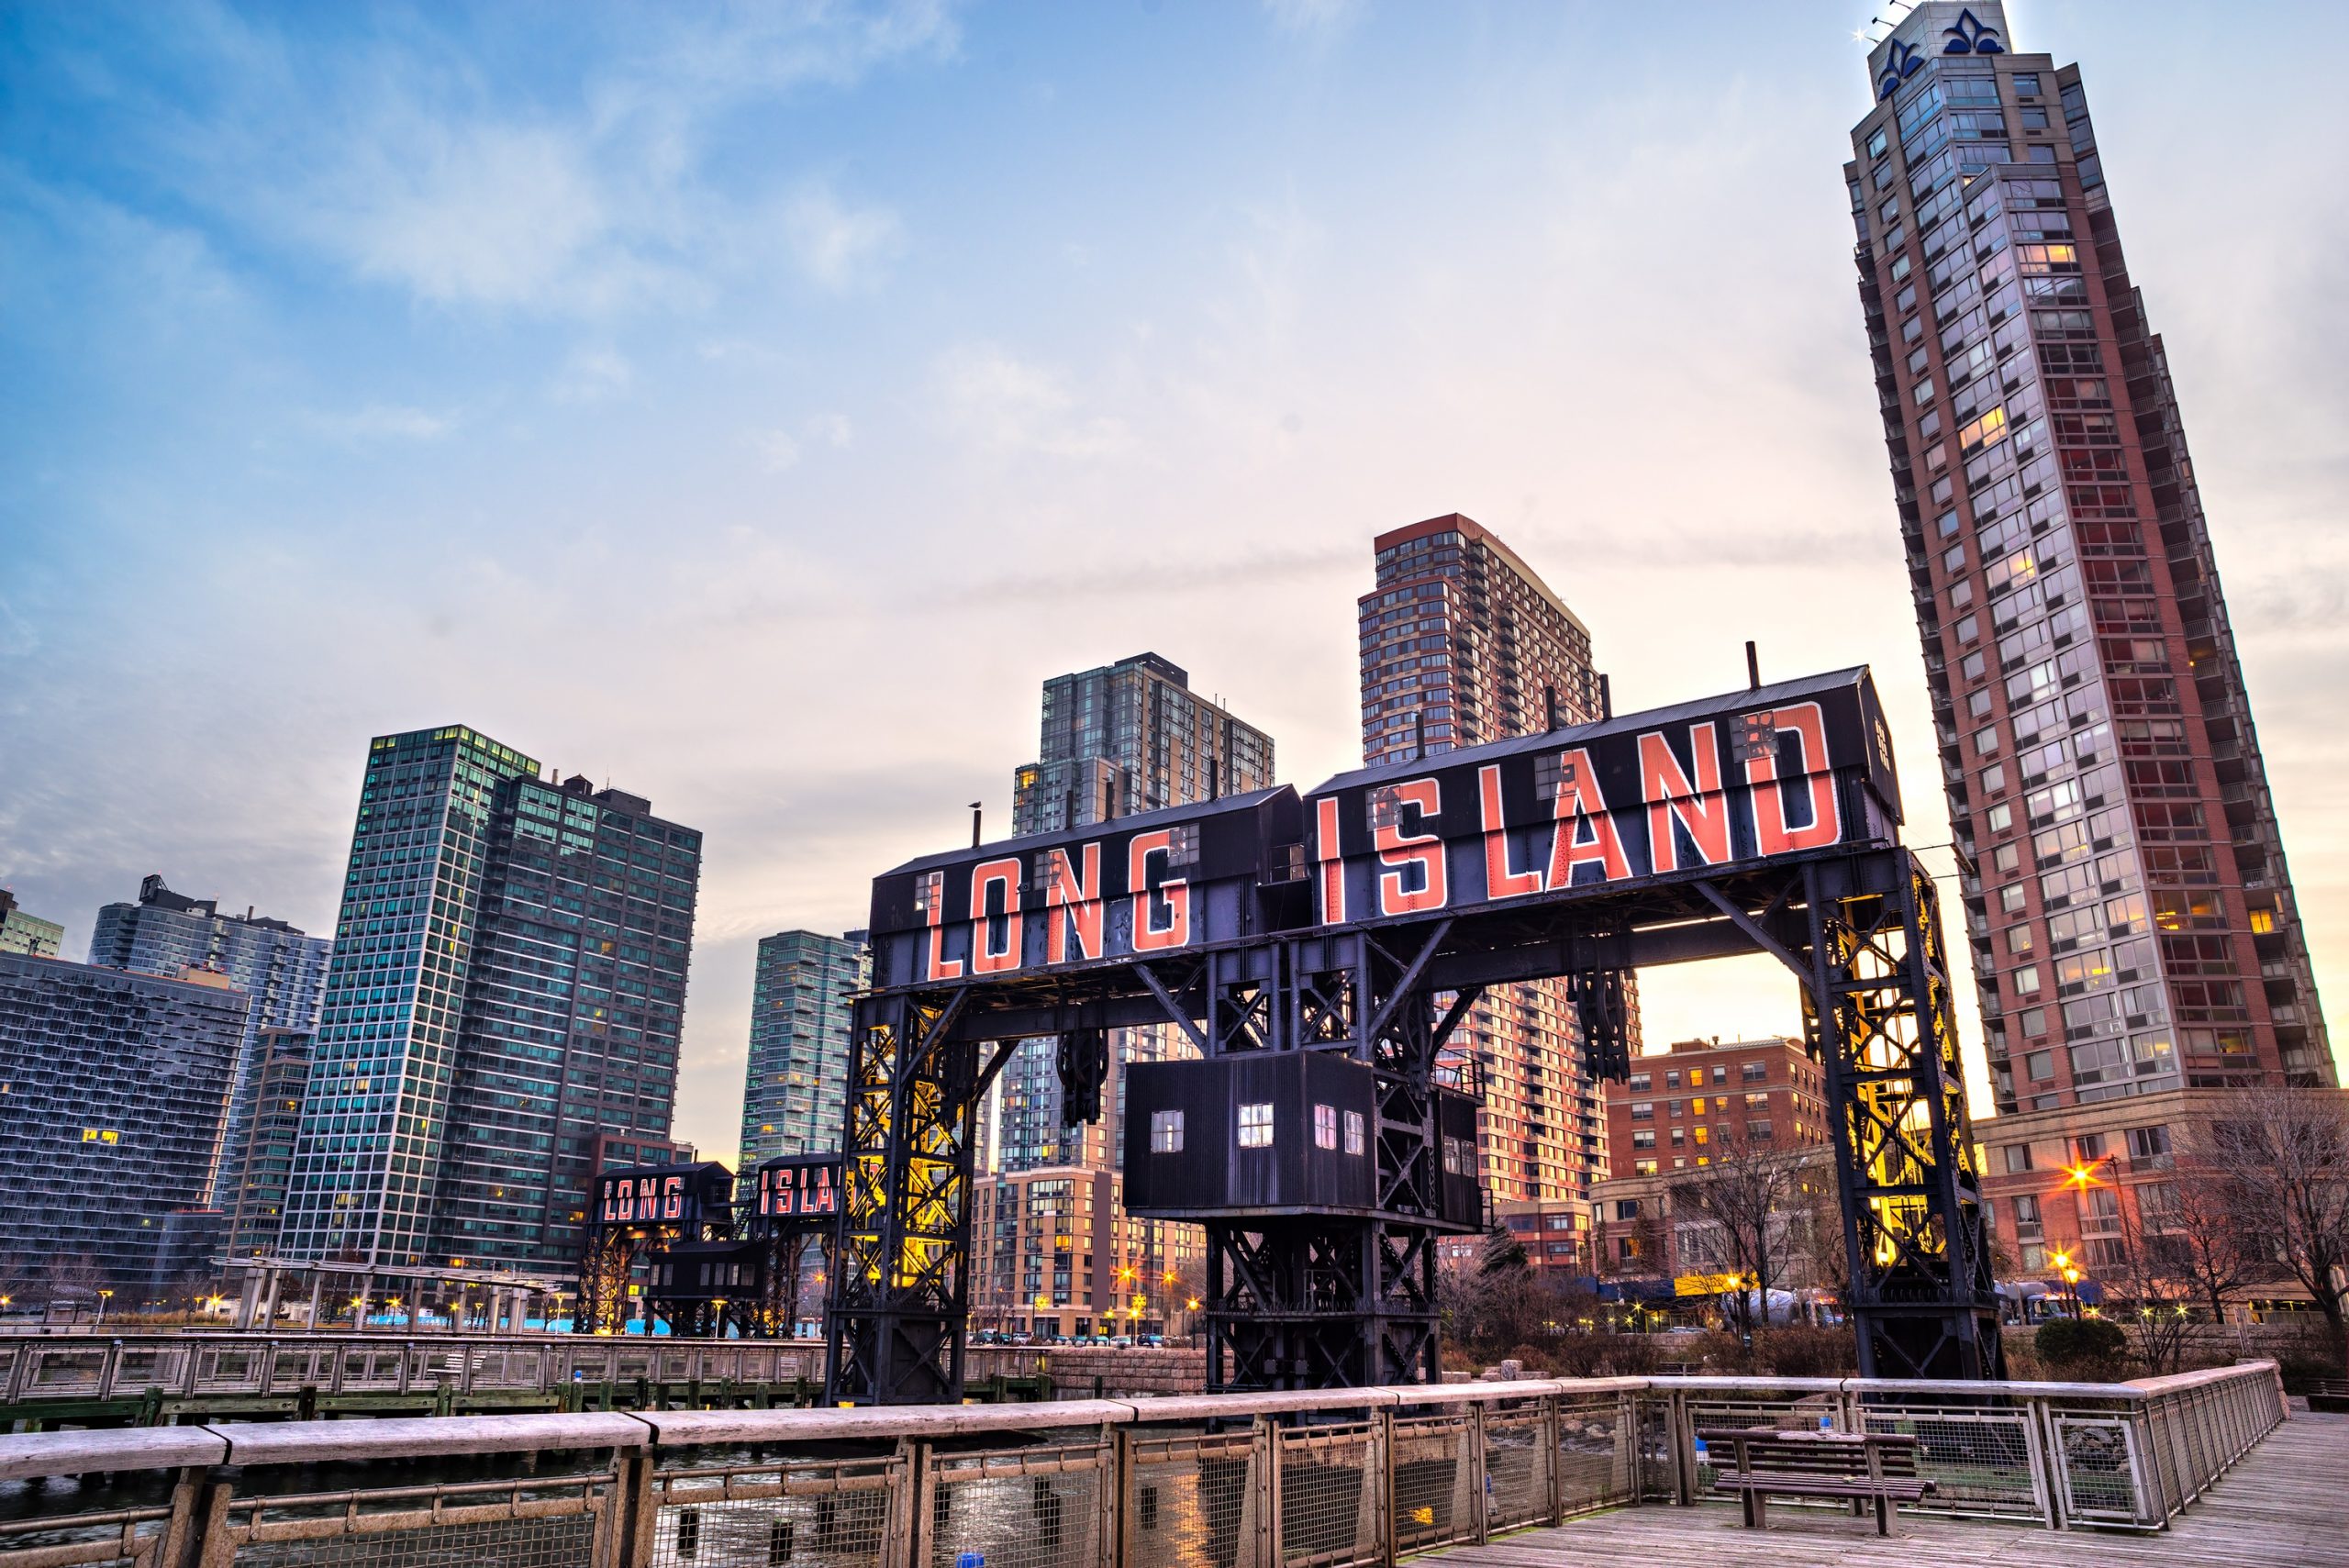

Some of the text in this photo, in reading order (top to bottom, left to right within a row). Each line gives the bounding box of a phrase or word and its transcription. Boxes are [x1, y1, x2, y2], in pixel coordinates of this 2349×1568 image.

[928, 701, 1842, 982] LONG ISLAND
[605, 1164, 878, 1220] LONG ISLA
